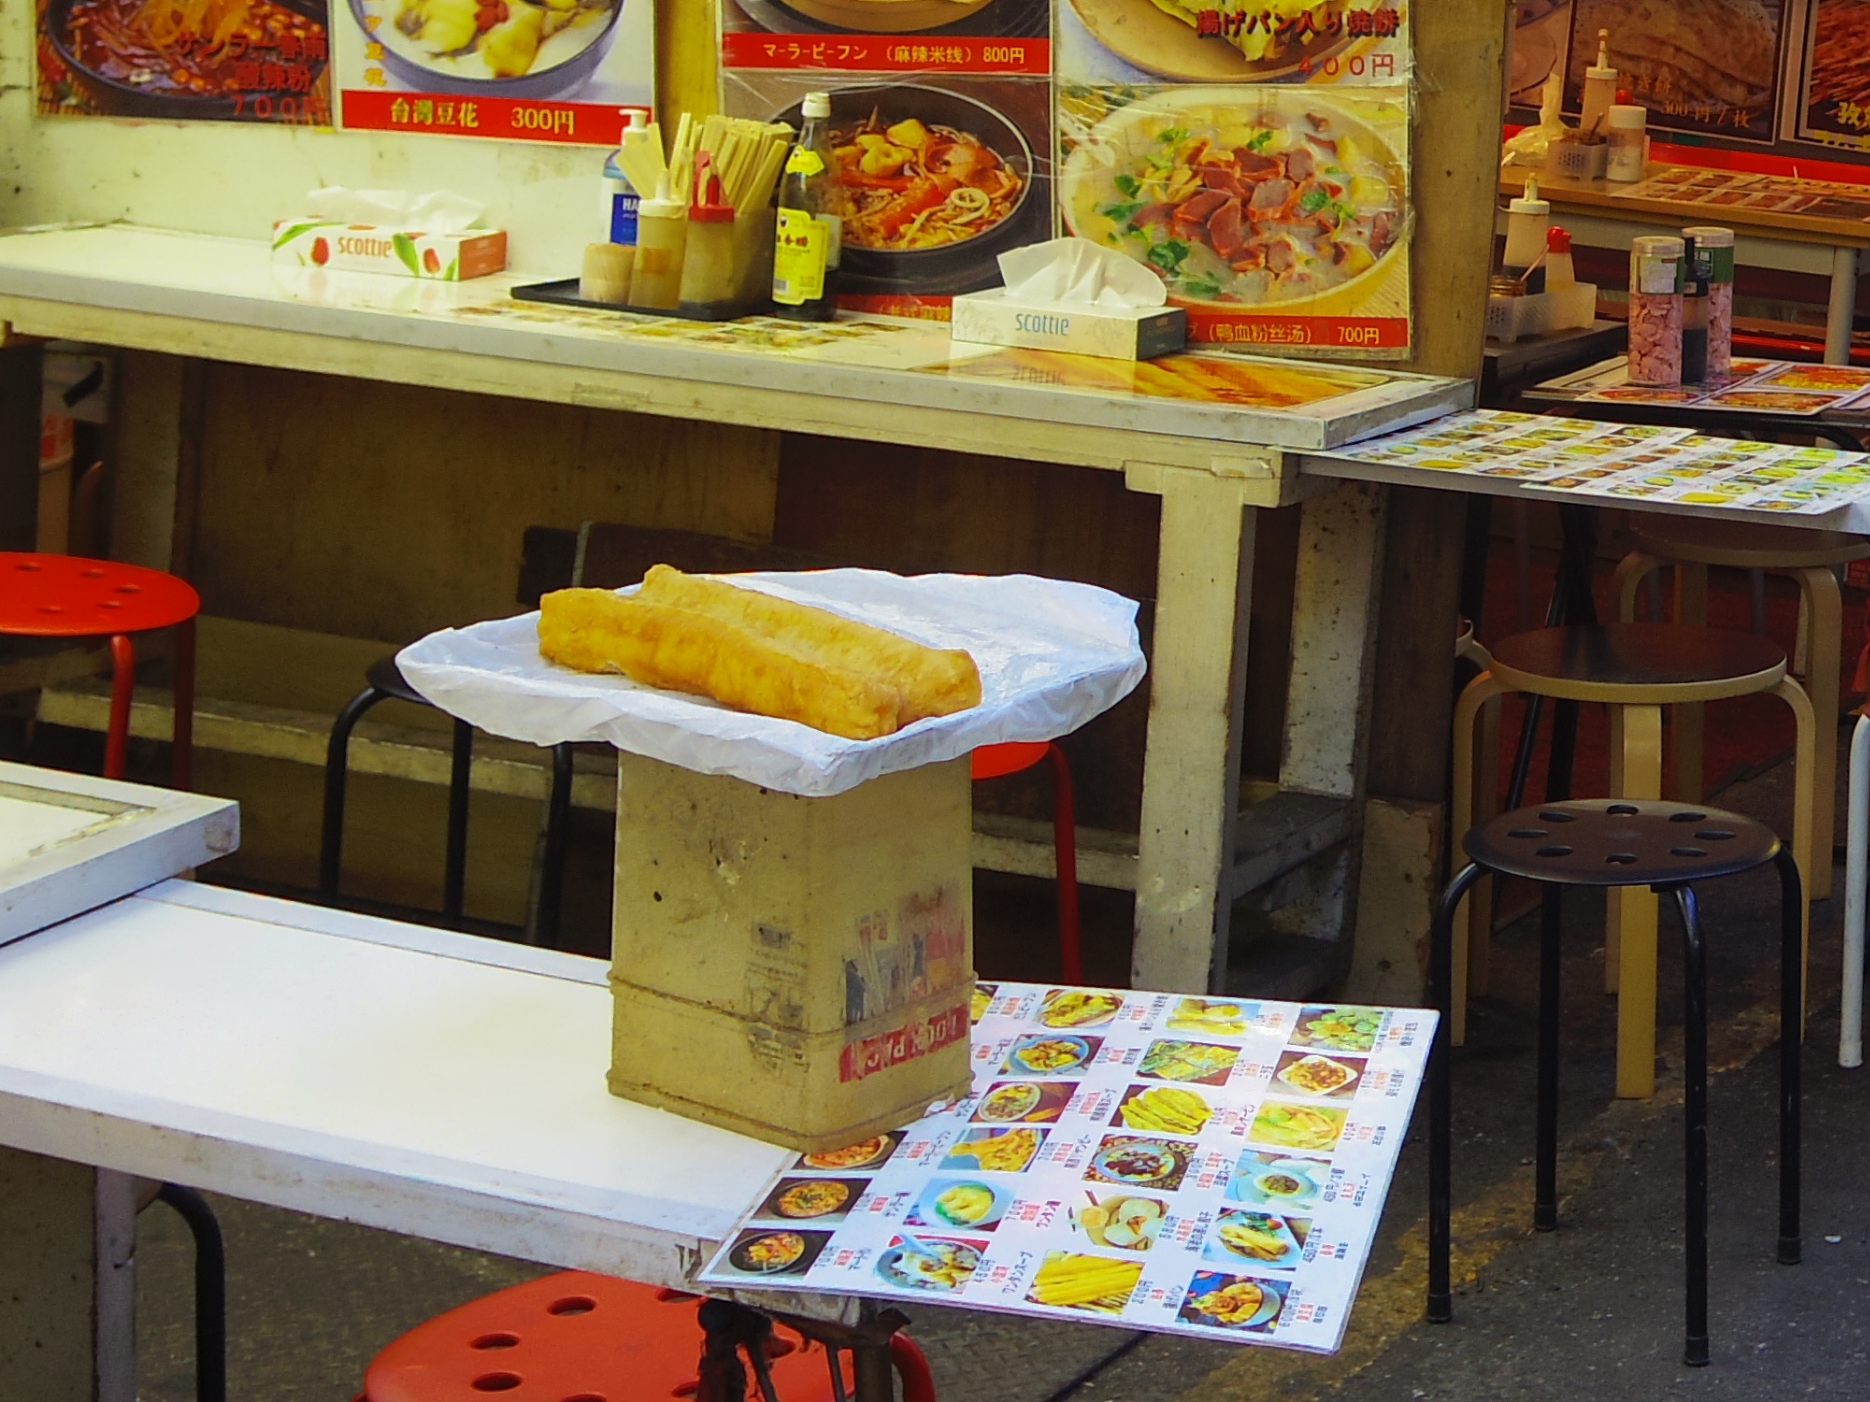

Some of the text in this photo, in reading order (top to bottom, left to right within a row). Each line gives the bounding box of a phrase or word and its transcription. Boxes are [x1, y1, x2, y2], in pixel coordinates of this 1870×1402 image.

[982, 46, 1026, 64] 800円
[1297, 53, 1395, 78] 400円
[509, 105, 576, 135] 300円
[336, 234, 395, 262] scottie
[1014, 311, 1070, 337] scottie
[1337, 326, 1381, 348] 700円
